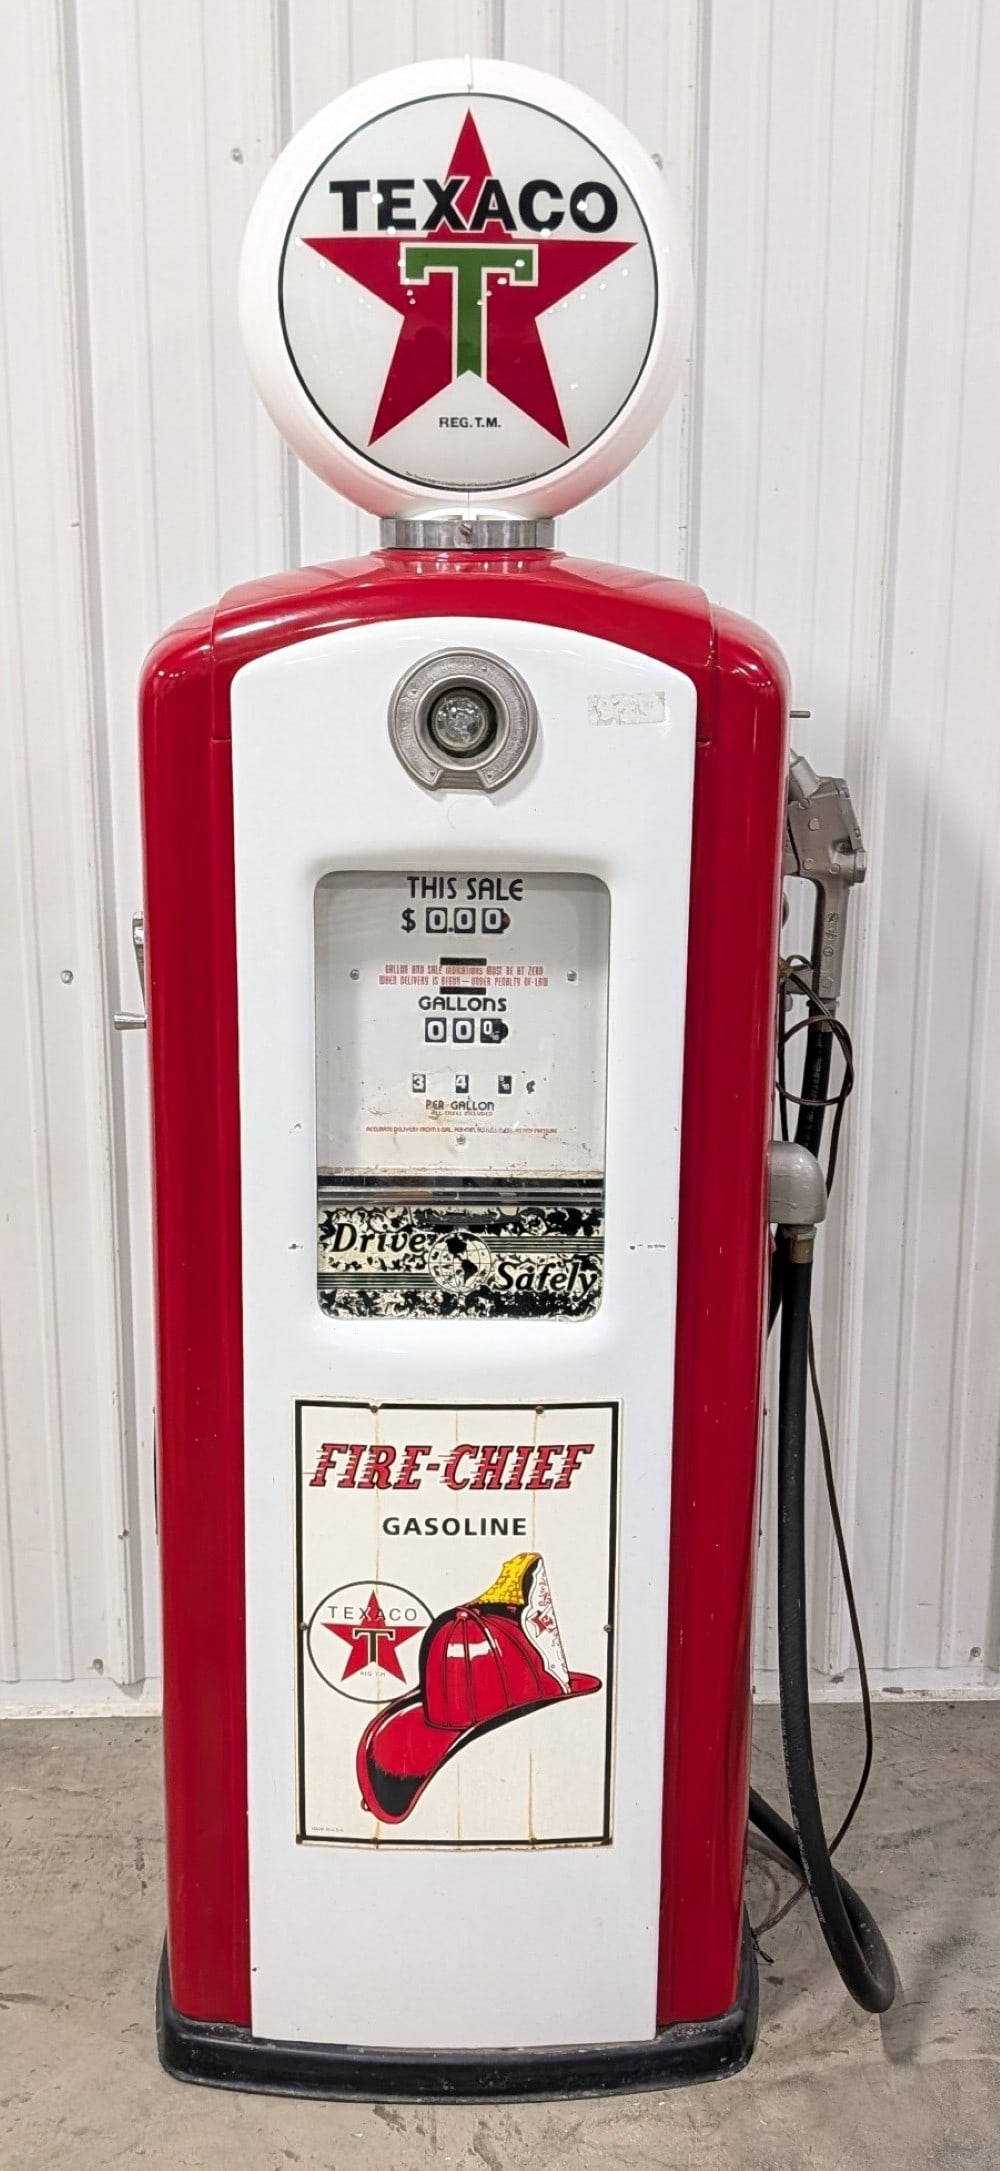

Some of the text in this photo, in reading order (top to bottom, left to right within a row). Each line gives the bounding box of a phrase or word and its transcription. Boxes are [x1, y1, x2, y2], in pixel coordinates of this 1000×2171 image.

[329, 178, 618, 233] TEXACO
[402, 245, 536, 380] T
[406, 876, 524, 901] THIS SALE
[400, 907, 416, 933] $
[379, 976, 396, 984] WHEN
[401, 976, 428, 985] DELIVERY
[433, 976, 438, 985] IS
[494, 977, 520, 986] PENALTY
[411, 964, 425, 974] AND
[486, 966, 502, 975] MUST
[506, 966, 513, 976] BE
[517, 966, 525, 976] AT
[528, 967, 543, 976] ZERO
[418, 996, 507, 1012] GALLONS
[413, 1074, 425, 1091] 3
[455, 1074, 467, 1091] 4
[425, 1100, 494, 1111] PER GALLON
[331, 1222, 427, 1253] Drive
[495, 1262, 598, 1302] Safely
[308, 1443, 595, 1490] FIRE-CHIEF
[382, 1516, 527, 1536] GASOLINE
[328, 1605, 417, 1622] TEXACO
[354, 1628, 394, 1664] T
